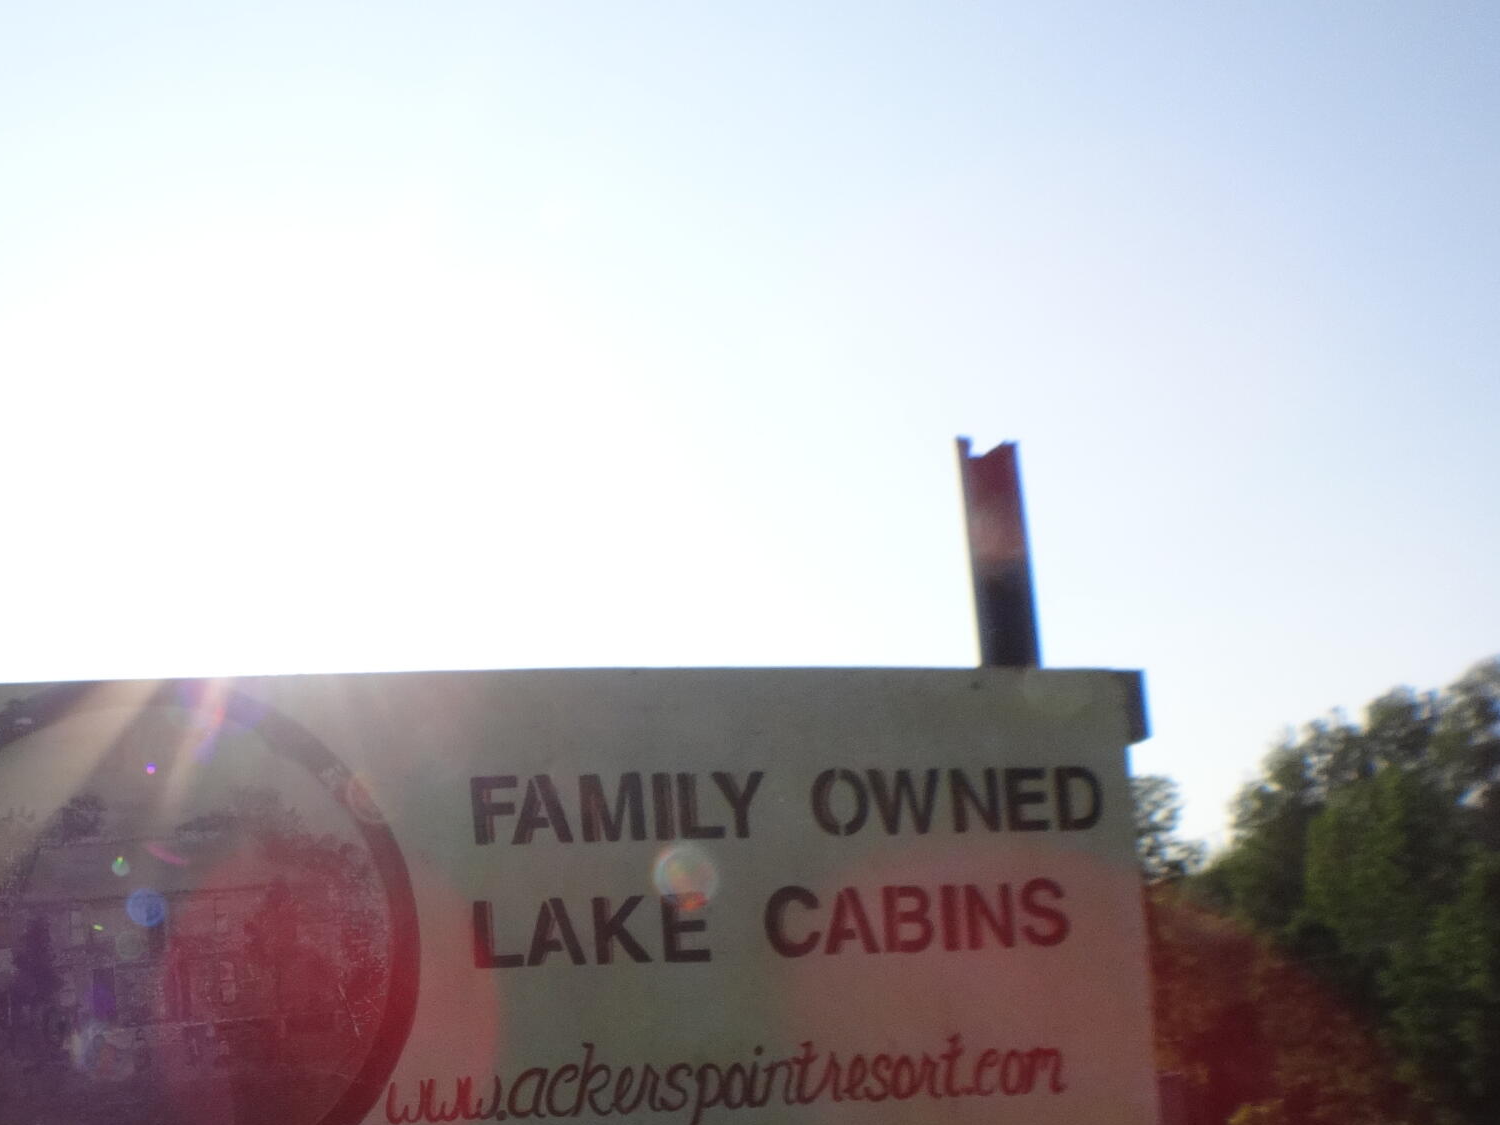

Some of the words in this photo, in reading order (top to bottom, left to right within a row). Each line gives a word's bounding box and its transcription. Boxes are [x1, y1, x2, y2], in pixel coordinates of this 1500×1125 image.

[469, 770, 765, 846] FAMILY
[811, 765, 1104, 837] OWNED
[471, 893, 712, 970] LAKE
[762, 877, 1073, 959] CABINS
